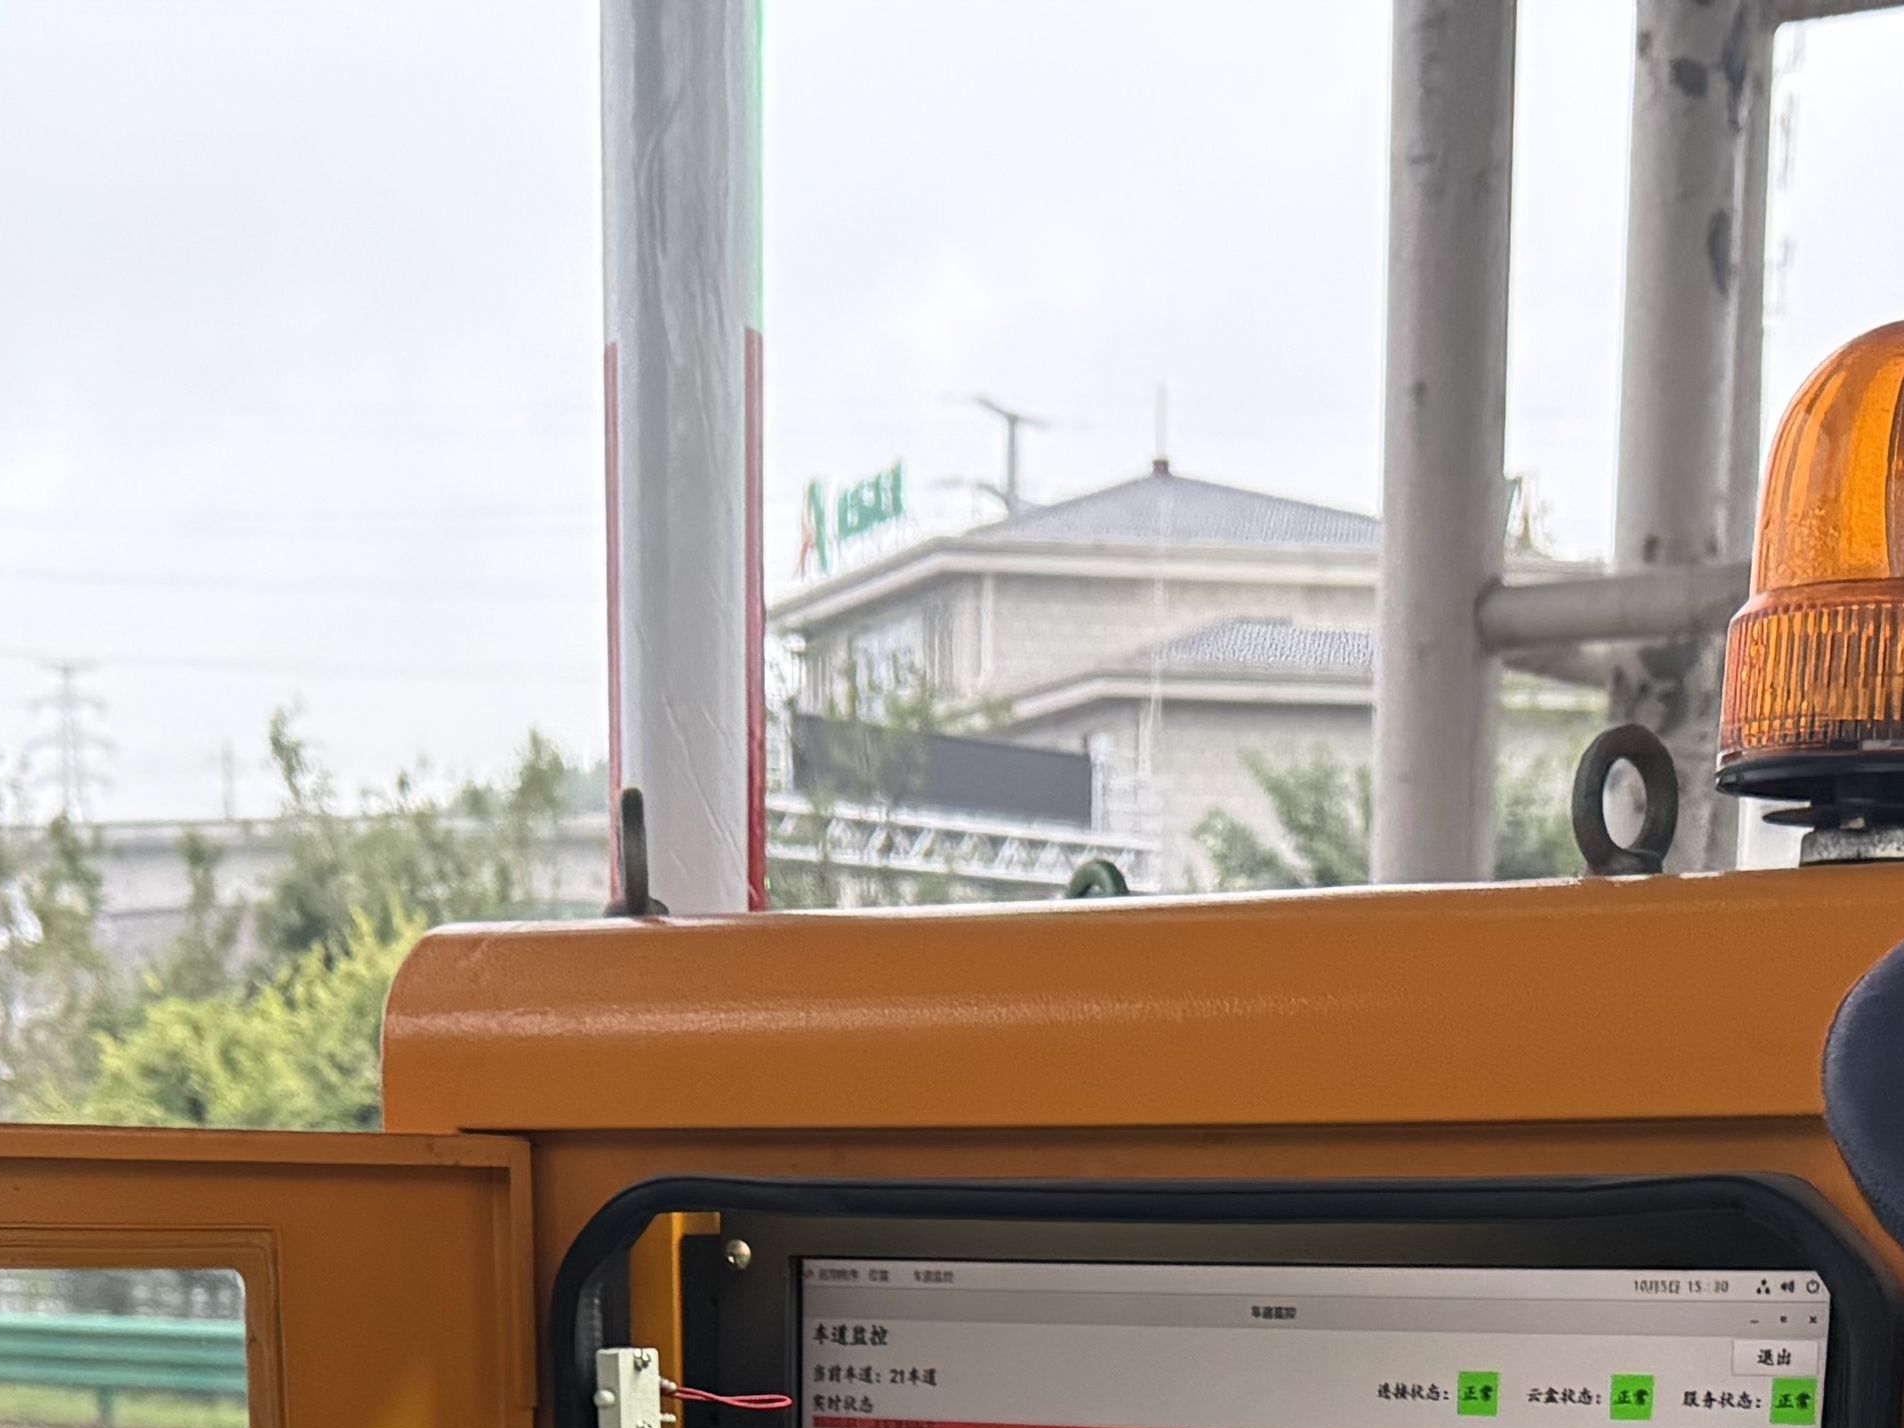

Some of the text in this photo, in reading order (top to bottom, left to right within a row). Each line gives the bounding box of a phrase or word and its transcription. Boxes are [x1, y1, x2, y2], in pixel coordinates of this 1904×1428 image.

[812, 1323, 890, 1347] 车道监控
[1756, 1347, 1794, 1369] 退出
[1461, 1383, 1495, 1403] 正常
[1617, 1388, 1650, 1408] 正常
[1774, 1391, 1811, 1411] 正常
[812, 1394, 874, 1414] 实时状态
